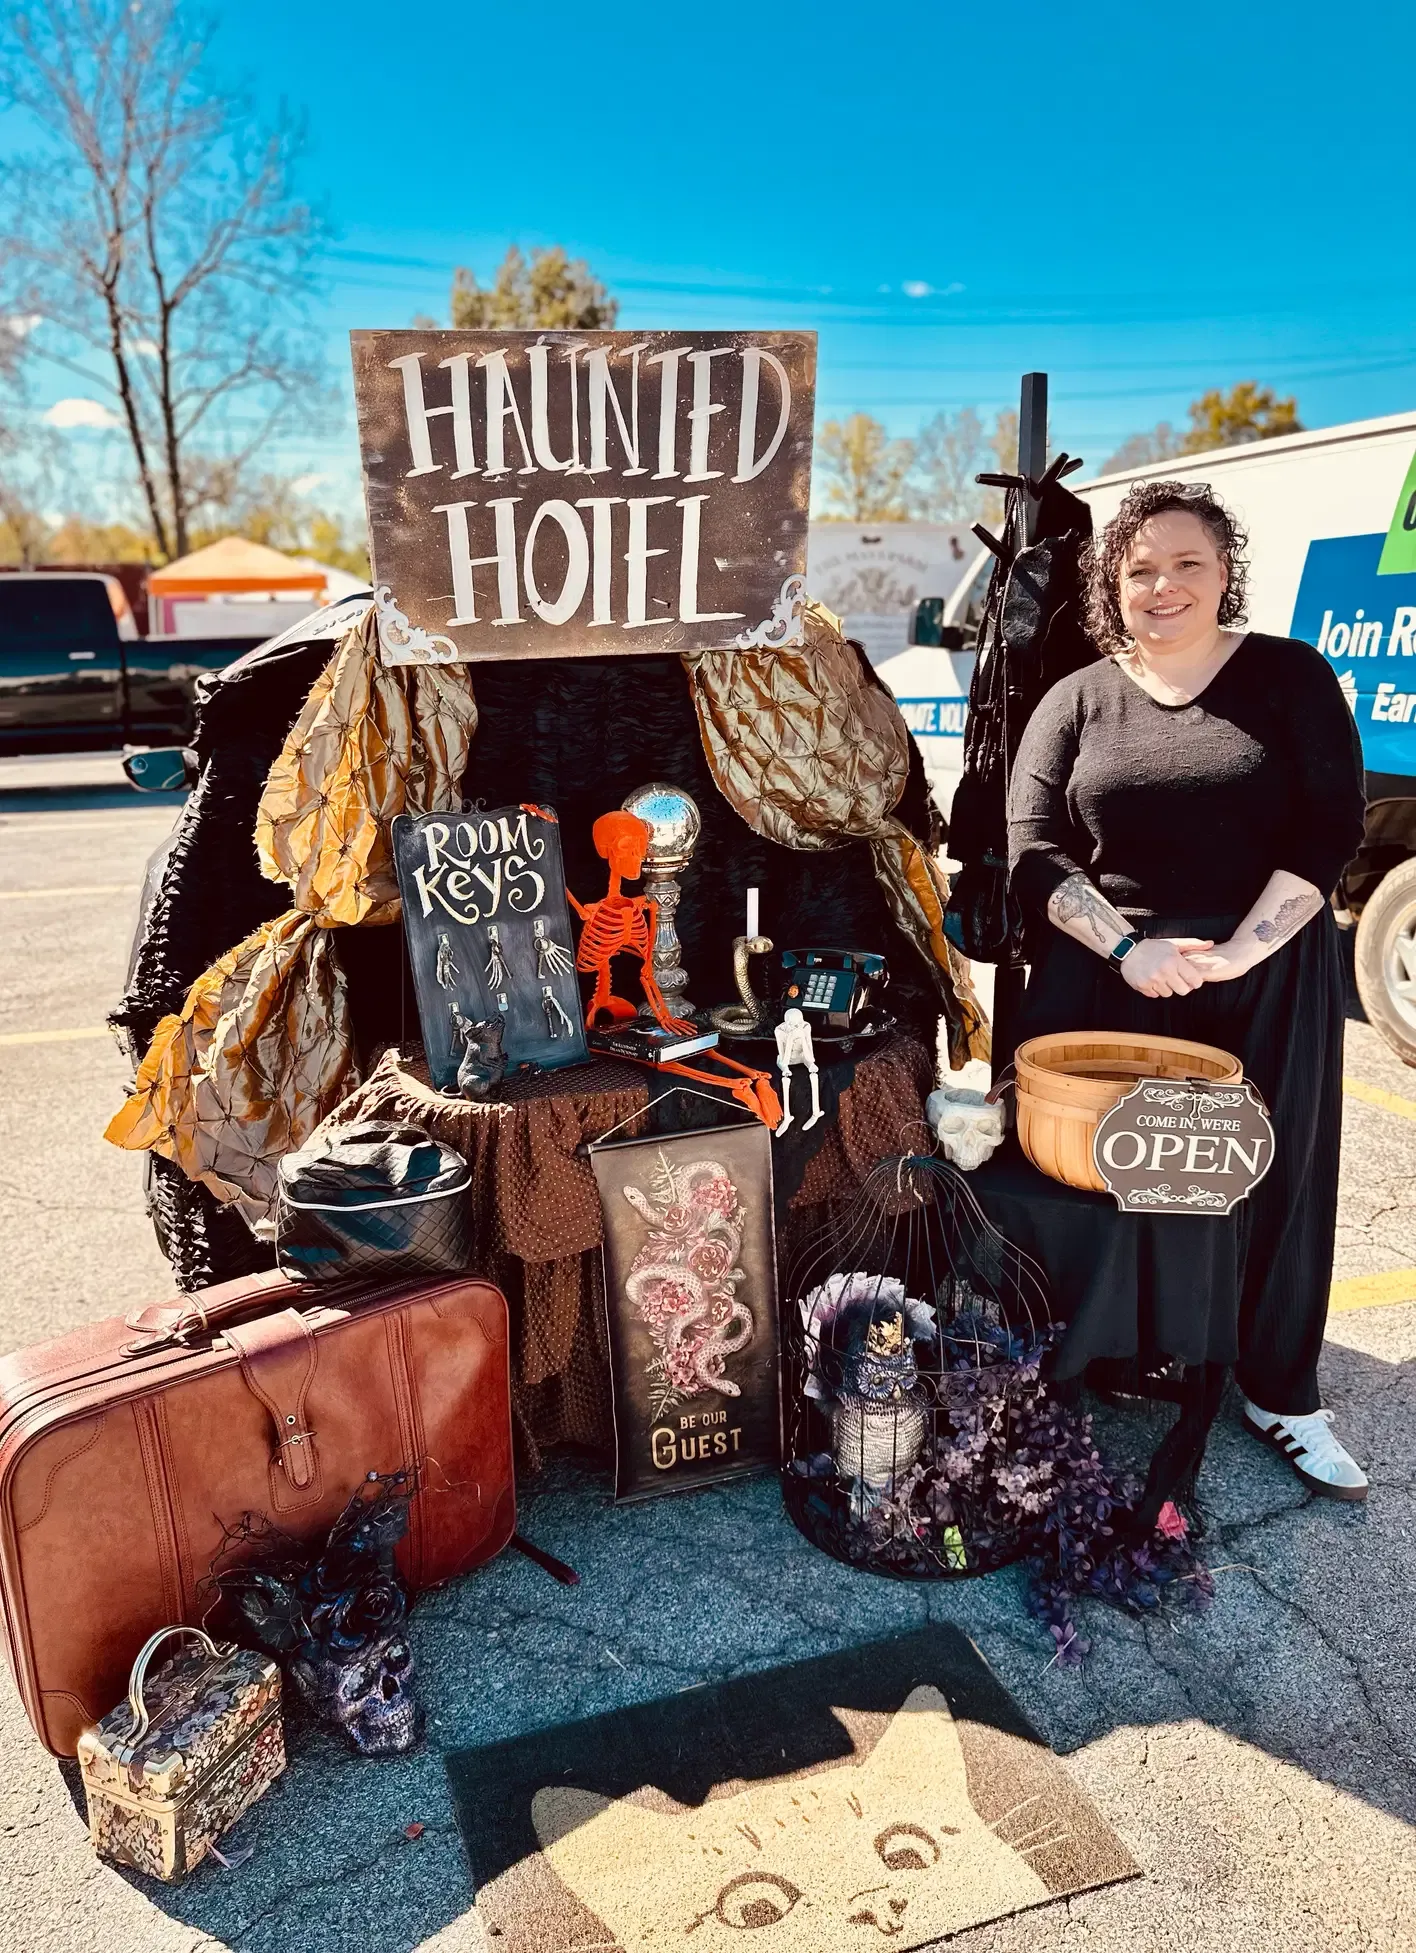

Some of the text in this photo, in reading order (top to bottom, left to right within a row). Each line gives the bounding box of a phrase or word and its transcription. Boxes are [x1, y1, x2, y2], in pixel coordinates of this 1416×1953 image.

[388, 336, 791, 484] HAUNTED
[431, 495, 746, 629] HOTEL
[1317, 606, 1416, 658] Join R
[1371, 682, 1416, 723] Ear
[421, 814, 545, 873] ROOM
[1136, 1115, 1177, 1129] COME
[1200, 1118, 1241, 1132] WE'RE
[1102, 1131, 1267, 1176] OPEN
[680, 1410, 728, 1429] BE OUR
